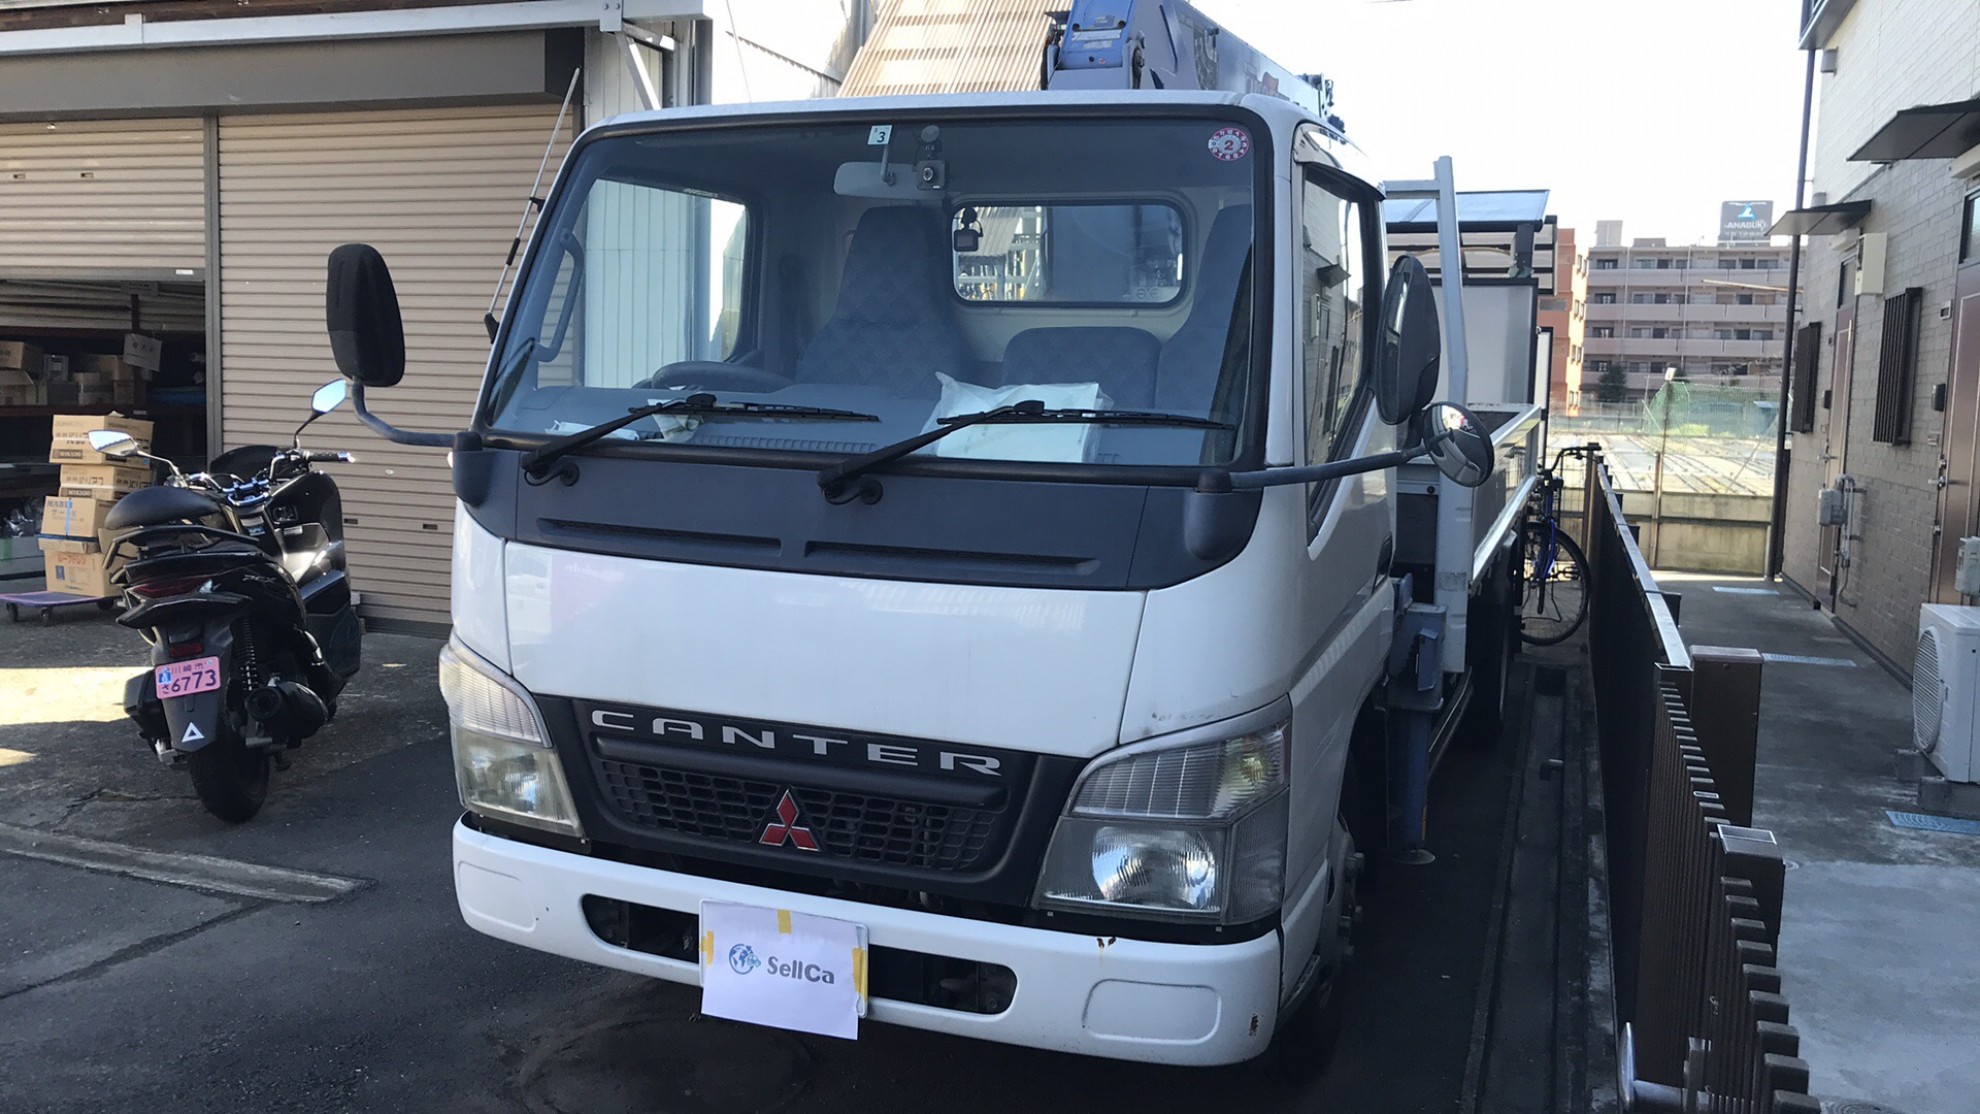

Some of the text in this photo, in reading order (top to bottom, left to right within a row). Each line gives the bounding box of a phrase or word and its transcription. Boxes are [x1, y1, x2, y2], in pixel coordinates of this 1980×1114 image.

[877, 131, 886, 143] 3
[1224, 139, 1234, 151] 2
[171, 668, 217, 693] 6773
[591, 709, 1002, 776] CANTER
[767, 956, 835, 984] SellCa
